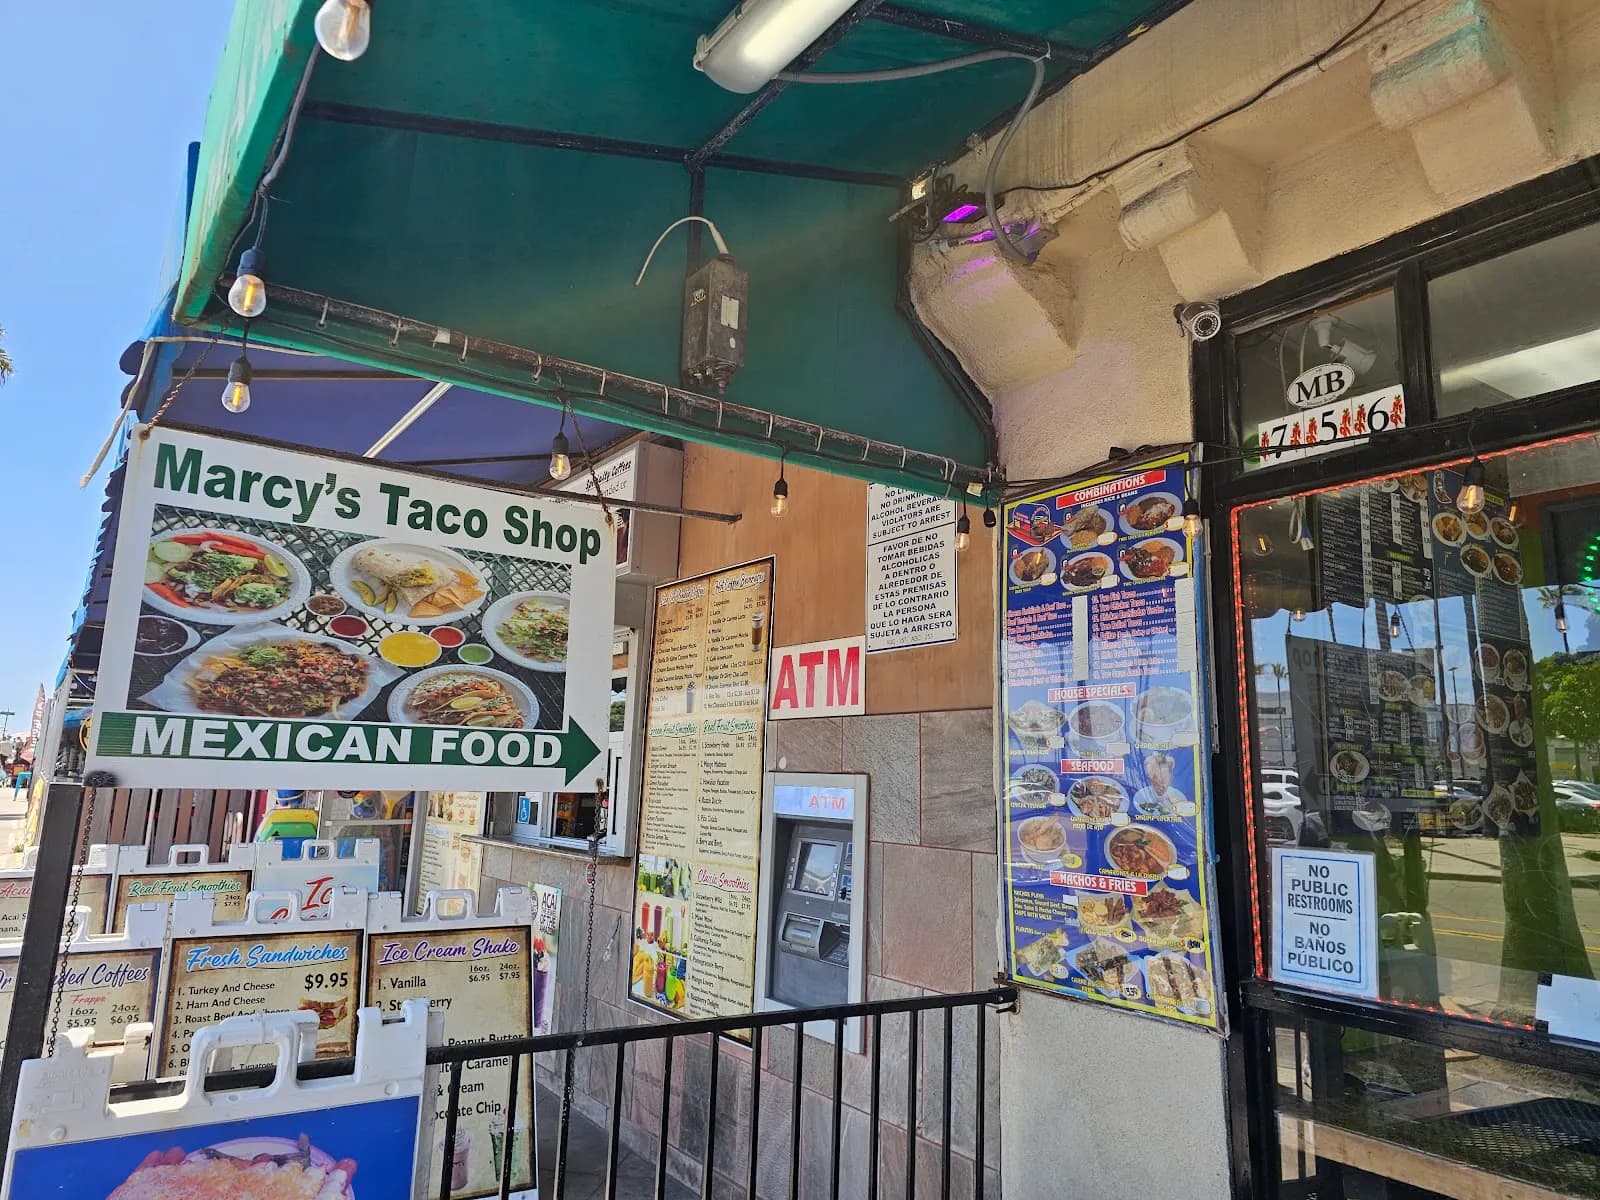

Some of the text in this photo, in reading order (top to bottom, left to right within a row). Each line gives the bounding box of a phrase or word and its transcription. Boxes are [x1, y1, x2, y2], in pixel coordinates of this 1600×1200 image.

[1296, 370, 1345, 404] MB
[885, 490, 896, 499] NO
[1074, 475, 1146, 502] COMBINATIONS
[154, 443, 601, 564] Marcy's Taco Shop
[872, 506, 905, 520] ALCOHOL
[880, 501, 891, 509] NO
[872, 510, 951, 539] SUBJECT TO ARREST
[882, 504, 941, 526] VIOLATORS ARE
[877, 540, 945, 563] TOMAR BEBIDAS
[883, 532, 938, 552] FAVOR DE NO
[880, 552, 940, 572] ALCOHOLICAS
[893, 566, 927, 579] DENTRO
[929, 562, 935, 570] O
[878, 571, 943, 590] ALREDEDOR DE
[875, 580, 947, 601] ESTAS PREMISAS
[872, 590, 949, 611] DE LO CONTRARIO
[883, 602, 936, 618] LA PERSONA
[870, 610, 952, 629] QUE LO HAGA SERA
[870, 628, 900, 639] SUJETA
[911, 620, 952, 632] ARRESTO
[772, 646, 861, 710] ATM
[1054, 685, 1129, 700] HOUSE SPECIALS
[131, 717, 563, 767] MEXICAN FOOD
[1071, 761, 1114, 773] SEAFOOD
[808, 795, 846, 810] ATM
[1308, 864, 1330, 878] NO
[129, 879, 241, 898] Real Fruit Smoothies
[1059, 872, 1137, 892] NACHOS & FRIES
[1291, 879, 1349, 897] PUBLIC
[302, 876, 333, 911] Ic
[1287, 893, 1353, 914] RESTROOMS
[1309, 921, 1330, 936] NO
[380, 937, 518, 963] Ice Cream Shake
[1295, 935, 1346, 955] BAÑOS
[187, 943, 348, 972] Fresh Sandwiches
[1288, 950, 1354, 974] PÚBLICO
[92, 963, 150, 988] Coffees
[304, 972, 348, 991] $9.95
[378, 976, 426, 991] 1. Vanilla
[469, 972, 520, 983] $6.95 $7.95
[178, 982, 275, 997] 1. Turkey And Cheese
[175, 996, 265, 1010] 2. Ham And Cheese
[67, 1015, 139, 1029] $5.95 $6.95
[173, 1016, 182, 1024] 3.
[185, 1013, 211, 1024] Roast
[172, 1030, 180, 1038] 4.
[170, 1045, 179, 1054] 5.
[168, 1060, 177, 1069] 6.
[476, 1100, 501, 1117] Chip
